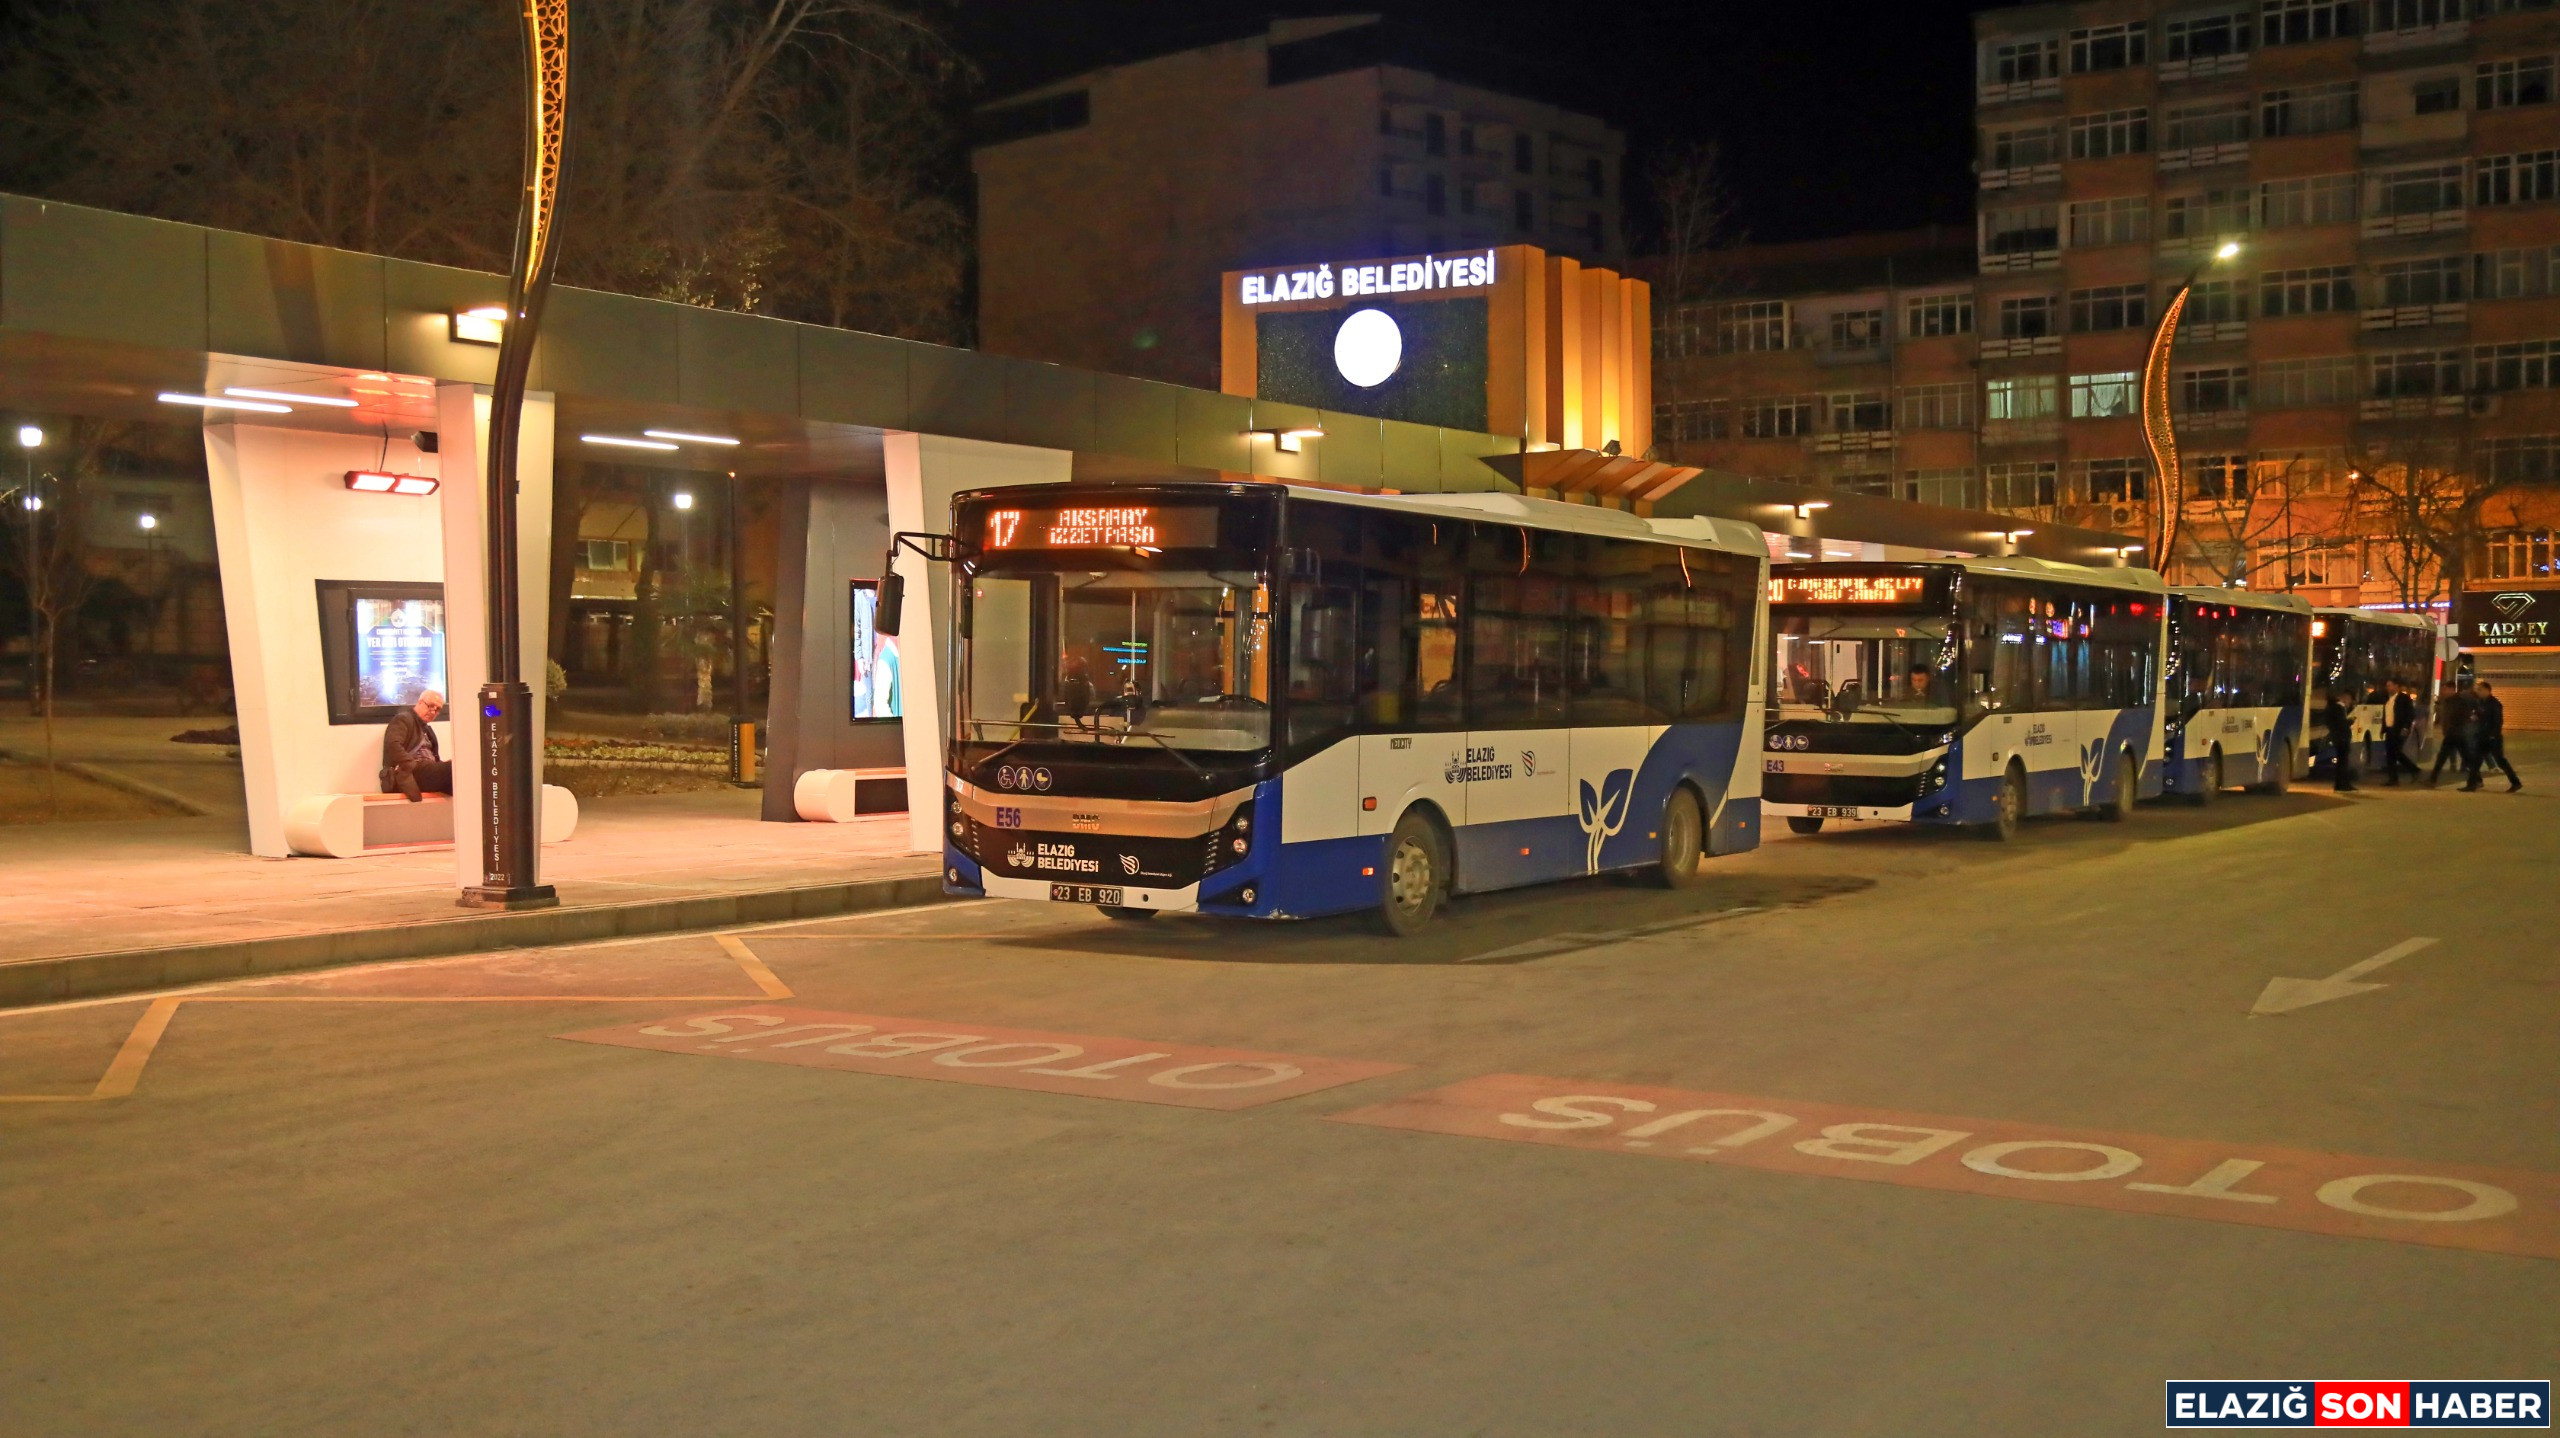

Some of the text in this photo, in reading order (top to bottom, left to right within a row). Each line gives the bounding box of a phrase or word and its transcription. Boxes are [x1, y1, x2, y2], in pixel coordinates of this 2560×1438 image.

[1242, 249, 1495, 304] ELAZIĞ BELEDİYESİ
[1059, 508, 1148, 526] AKSARAY
[990, 511, 1020, 547] 17
[1466, 746, 1495, 763] ELAZIĞ
[1466, 764, 1512, 782] BELEDİYESİ
[1766, 760, 1785, 773] E43
[996, 806, 1021, 828] E56
[1812, 807, 1822, 816] 23
[1842, 808, 1857, 817] 939
[1037, 842, 1075, 858] ELAZIĞ
[1037, 857, 1099, 873] BELEDİYESİ
[490, 873, 505, 881] 2022
[1057, 886, 1120, 905] 23 EB 920
[638, 1013, 1304, 1091] OTOBÜS
[1499, 1094, 2519, 1222] OTOBÜS
